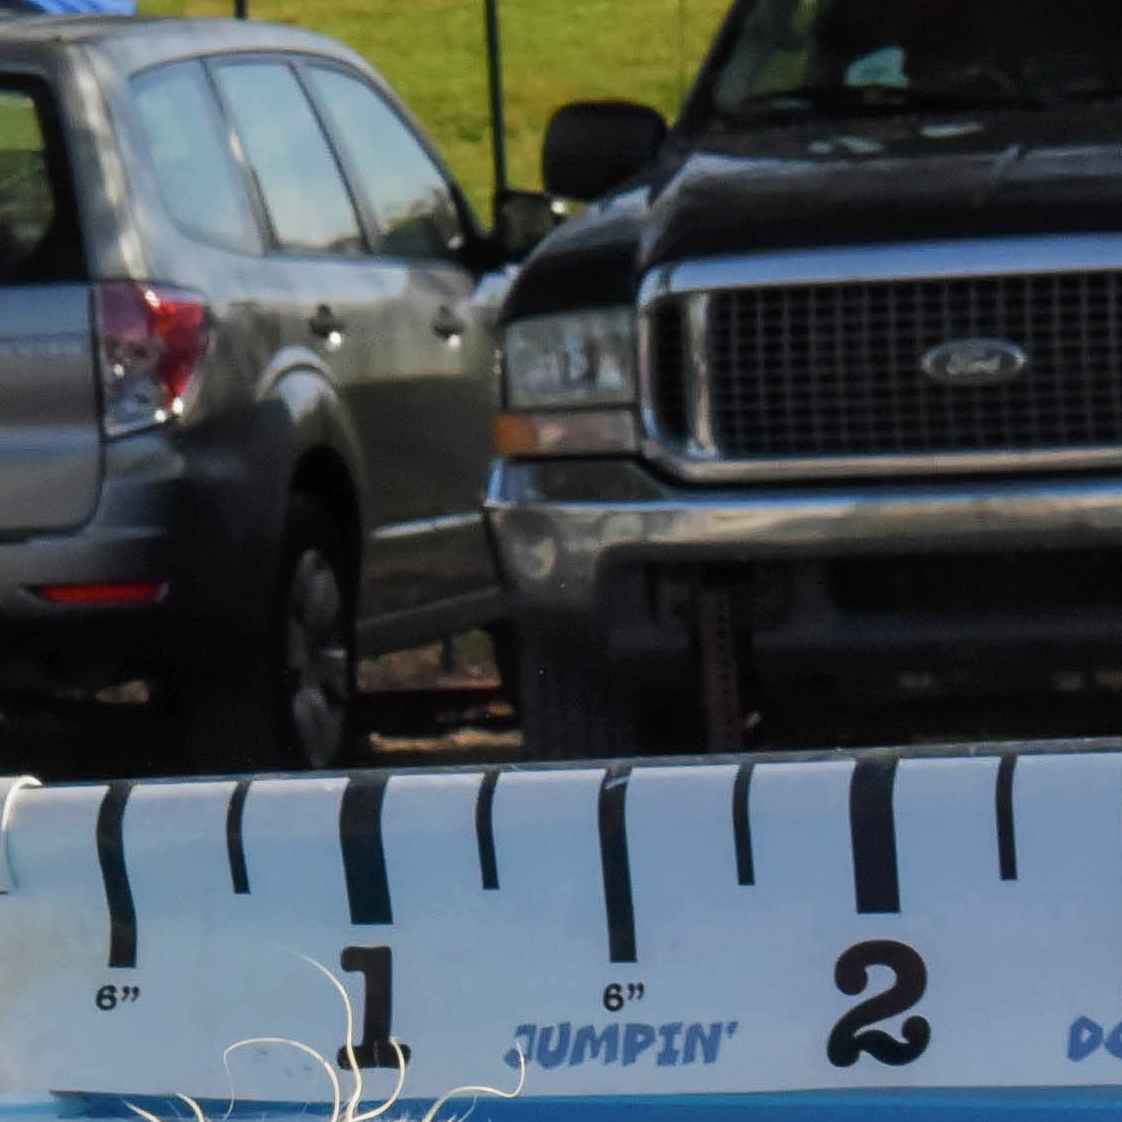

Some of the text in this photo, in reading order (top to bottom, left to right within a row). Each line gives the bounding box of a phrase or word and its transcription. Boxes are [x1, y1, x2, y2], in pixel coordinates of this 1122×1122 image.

[337, 945, 411, 1069] 1
[503, 1020, 739, 1069] JUMPIN'
[826, 939, 931, 1068] 2
